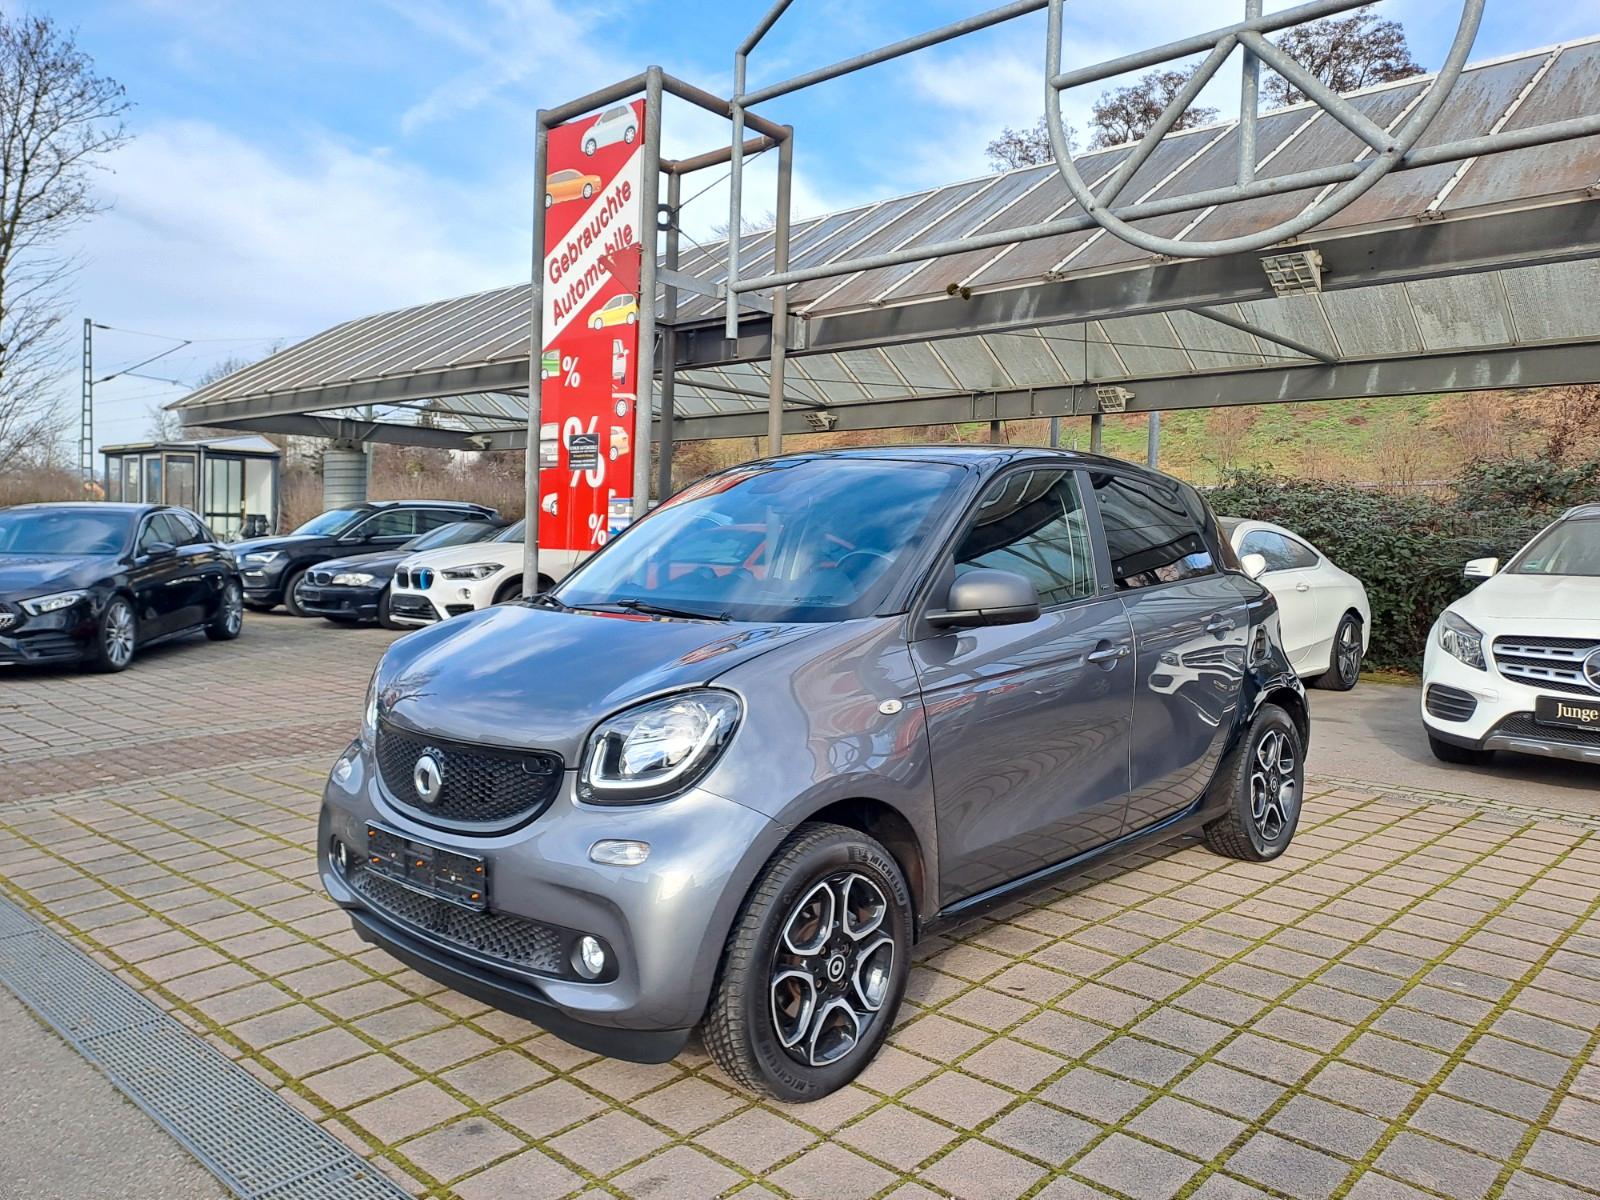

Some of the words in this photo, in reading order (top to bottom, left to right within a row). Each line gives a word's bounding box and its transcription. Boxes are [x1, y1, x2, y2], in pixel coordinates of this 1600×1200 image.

[548, 180, 632, 285] Gebrauchte
[563, 355, 581, 388] %
[588, 513, 607, 545] %
[1556, 702, 1599, 722] Junge
[869, 855, 905, 904] MICHELIN
